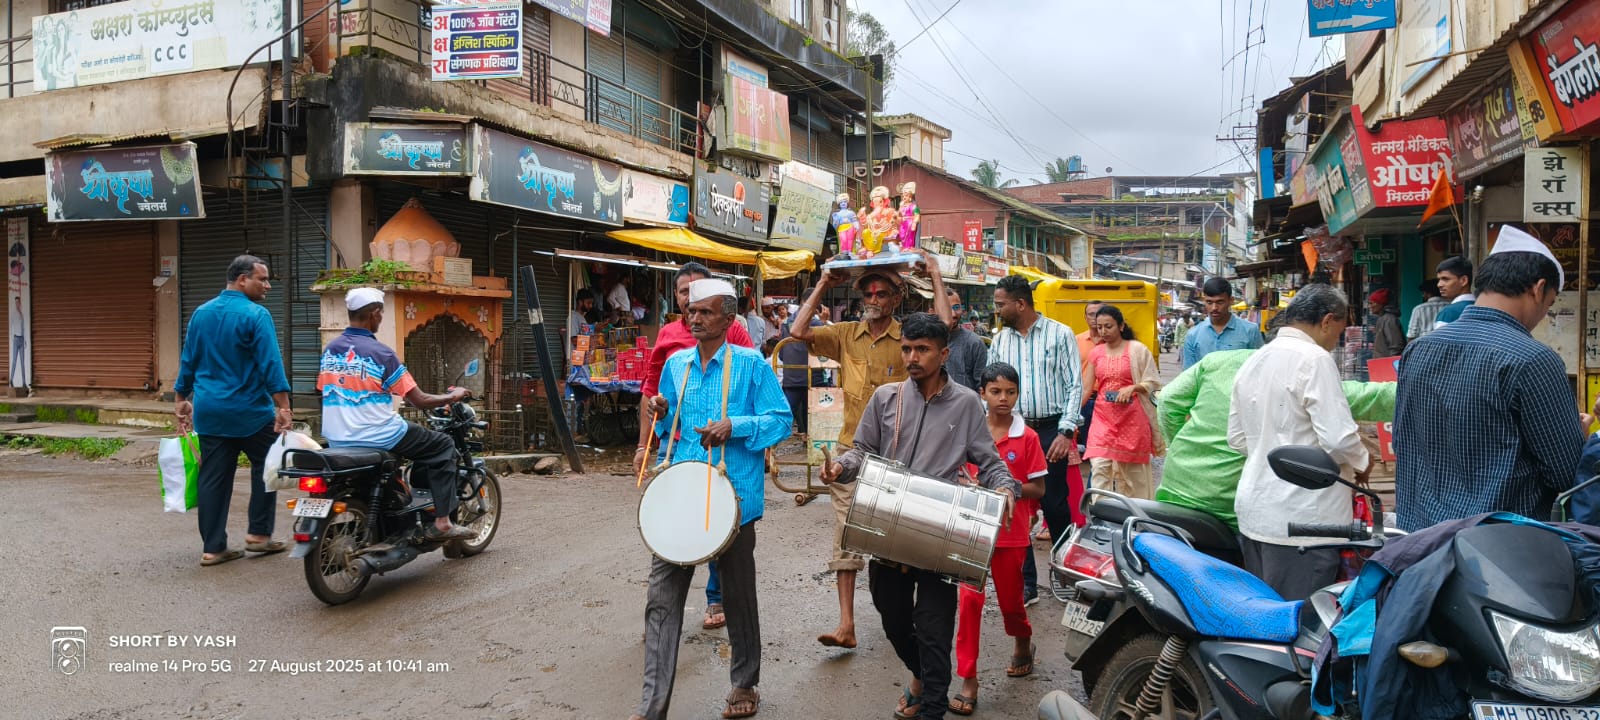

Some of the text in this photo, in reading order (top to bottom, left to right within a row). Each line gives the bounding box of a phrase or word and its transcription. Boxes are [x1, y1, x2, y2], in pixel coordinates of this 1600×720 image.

[90, 13, 133, 42] अक्षरा
[451, 17, 476, 29] 100%
[477, 13, 494, 28] जॉब
[453, 33, 515, 51] इंग्लिश स्पिकिंग
[450, 54, 517, 70] संगणक प्रशिक्षण
[1371, 139, 1405, 155] तन्मय
